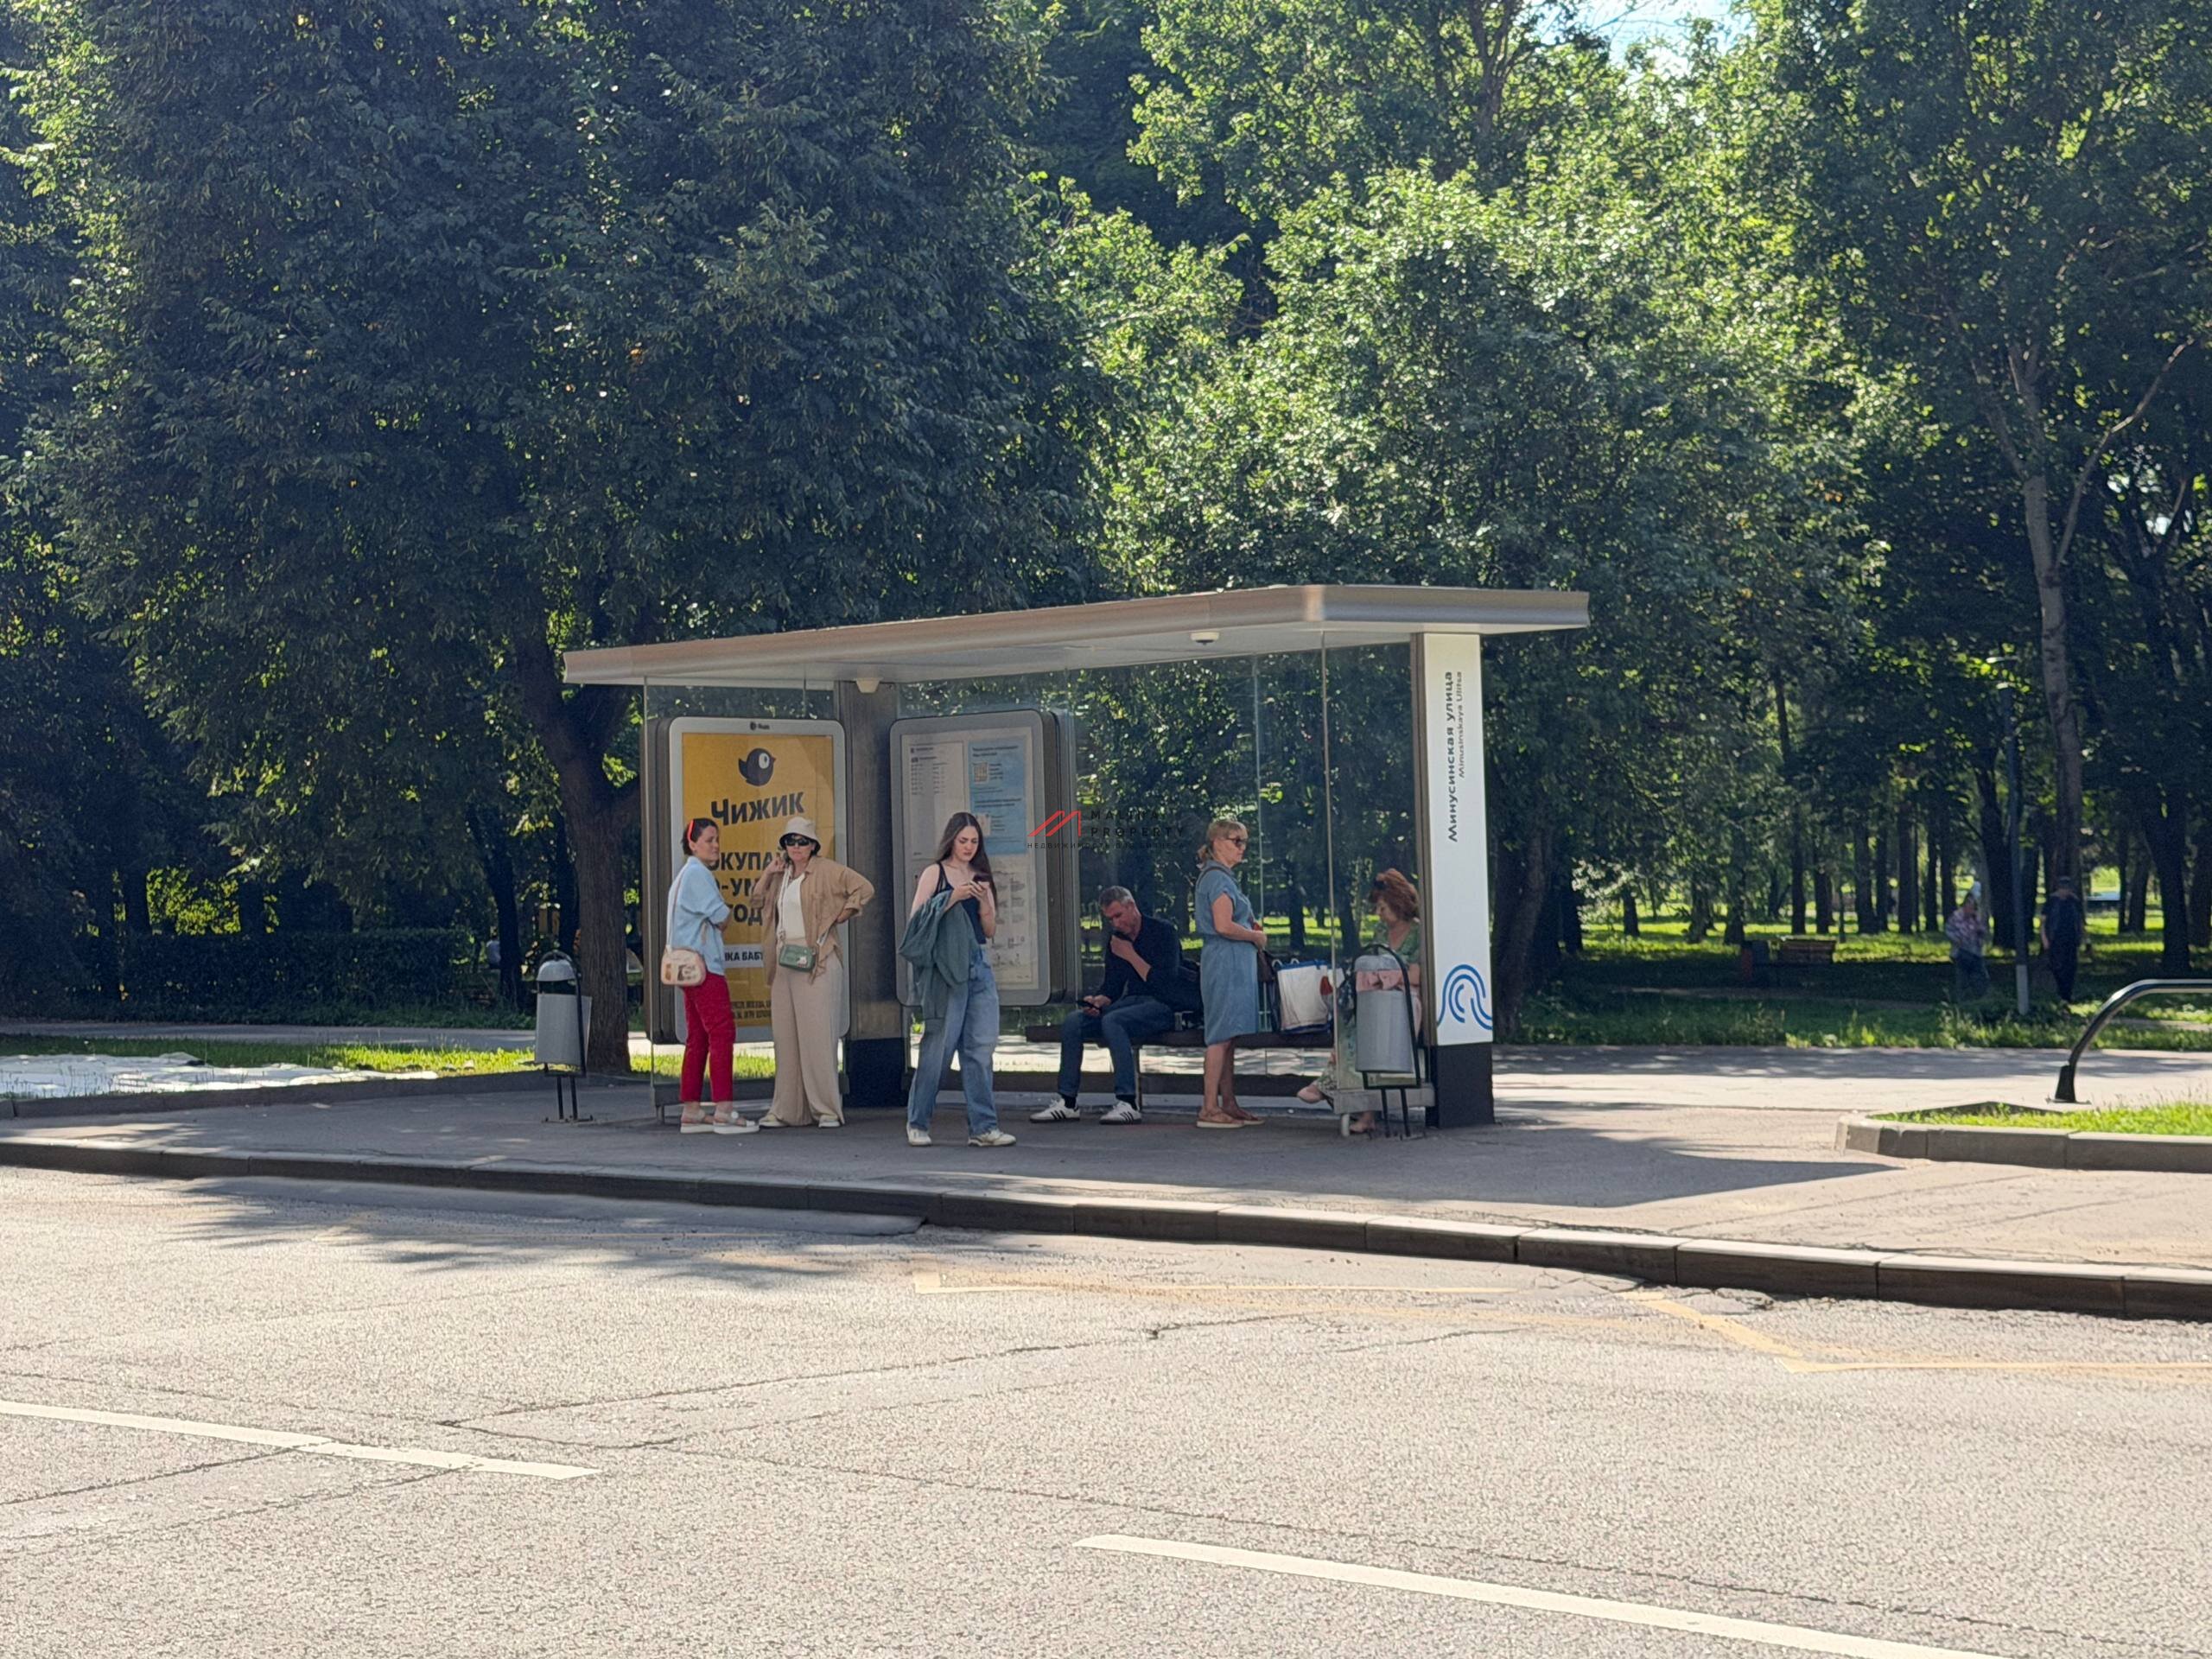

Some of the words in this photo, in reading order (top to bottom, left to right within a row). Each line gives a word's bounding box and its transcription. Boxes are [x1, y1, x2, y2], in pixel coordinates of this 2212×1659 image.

[1445, 671, 1456, 722] улица
[1457, 704, 1465, 779] Minusinskaya
[1446, 727, 1459, 842] Минусинская
